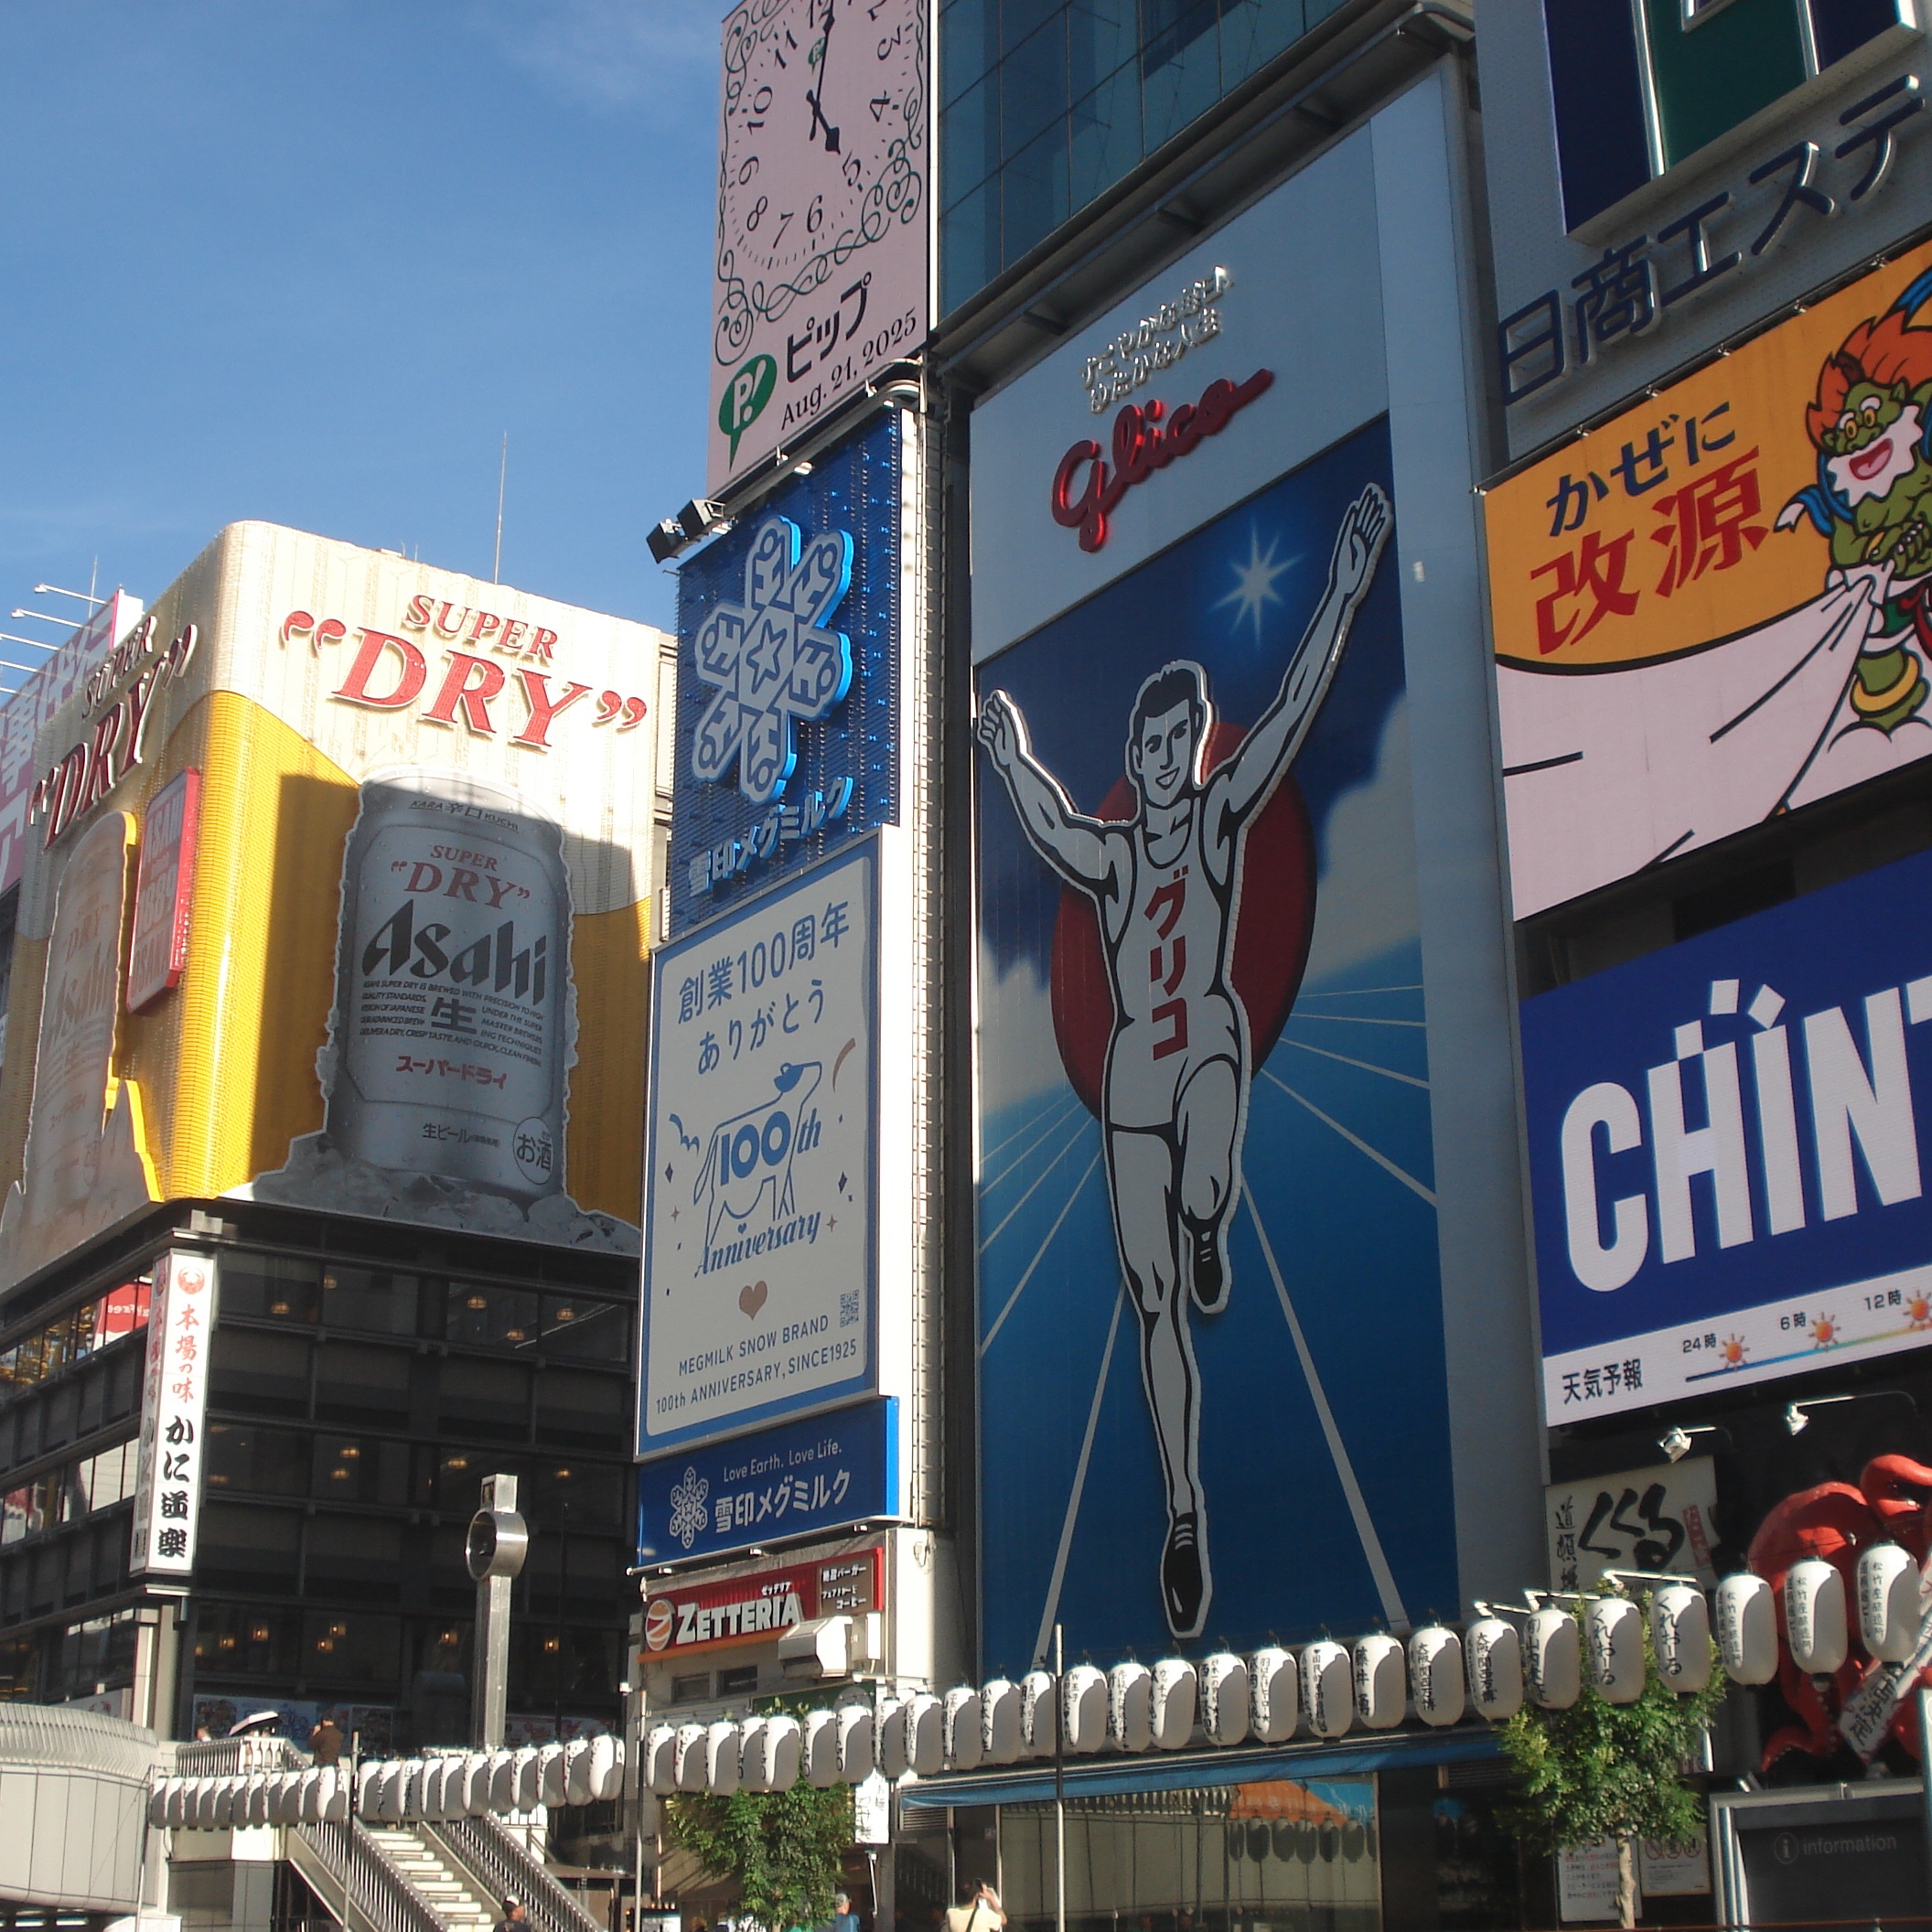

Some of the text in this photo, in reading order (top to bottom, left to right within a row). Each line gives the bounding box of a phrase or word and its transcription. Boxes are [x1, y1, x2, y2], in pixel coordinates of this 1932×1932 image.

[774, 28, 798, 70] 11
[876, 25, 901, 60] 3
[746, 86, 774, 134] 10
[869, 91, 890, 123] 4
[739, 156, 759, 185] 9
[842, 152, 861, 185] 5
[746, 196, 767, 231] 8
[773, 212, 794, 248] 7
[807, 195, 823, 232] 6
[787, 272, 872, 383] ピップ
[781, 311, 917, 430] Aug. 21, 2025
[1546, 402, 1736, 537] かぜに
[1530, 445, 1769, 655] 改源
[405, 594, 559, 659] SUPER
[410, 800, 520, 833] KARA 辛口 KUCHI
[689, 776, 853, 896] 雪印メグミルク
[430, 845, 498, 872] SUPER
[361, 899, 547, 1007] Asahi
[678, 901, 850, 1025] 創業100周年
[1144, 865, 1188, 1061] グリコ
[431, 997, 478, 1035] 生
[698, 979, 825, 1076] ありがとう
[396, 1056, 507, 1089] スーパードライ
[423, 1123, 470, 1143] 生ビール
[719, 1109, 822, 1186] 100th
[694, 1211, 821, 1278] Anniversary
[1780, 1312, 1807, 1332] 6時
[1864, 1289, 1902, 1311] 12時
[172, 1304, 199, 1405] 本場の味
[679, 1315, 829, 1376] MEGMILK SNOW BRAND
[1682, 1333, 1717, 1354] 24時
[656, 1392, 686, 1414] 100th
[1562, 1358, 1643, 1405] 天気予報
[724, 1438, 842, 1483] Love Earth. Love Life.
[714, 1468, 851, 1534] 雪印メグミルク
[1578, 1483, 1686, 1571] くくる
[676, 1593, 801, 1645] ZETTERIA
[836, 1596, 867, 1610] コーヒー
[1803, 1835, 1897, 1855] information
